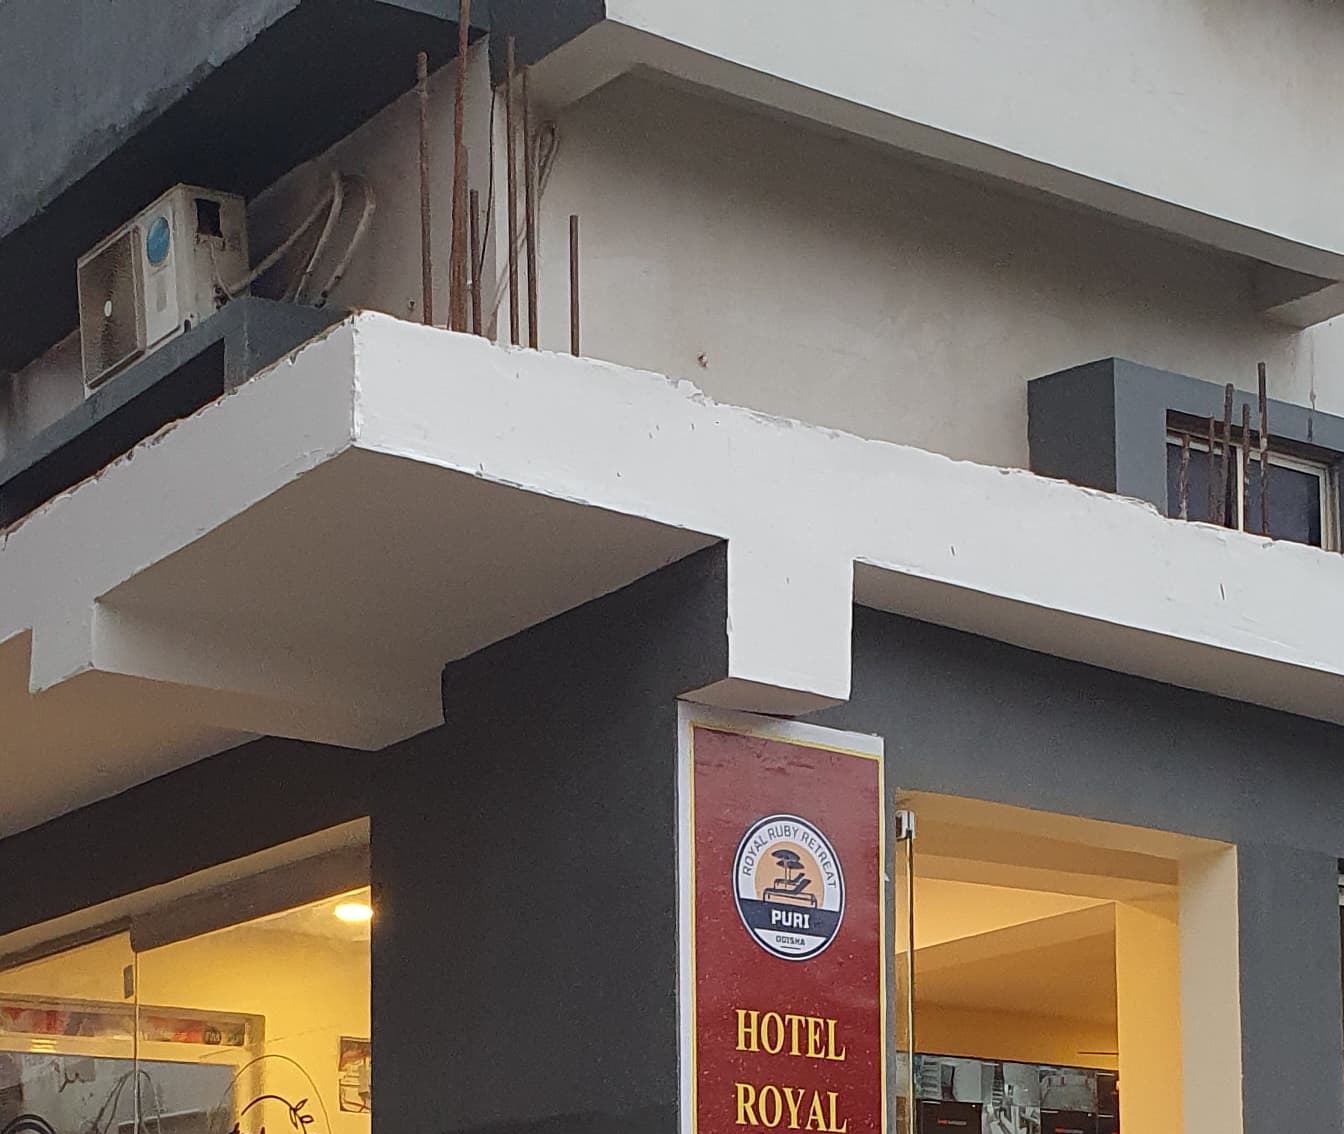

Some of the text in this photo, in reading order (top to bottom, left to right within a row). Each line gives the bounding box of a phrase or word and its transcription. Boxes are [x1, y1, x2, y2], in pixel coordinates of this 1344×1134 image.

[742, 825, 837, 889] ROYAL RUBY RETREAT
[771, 909, 810, 929] PURI
[775, 935, 806, 946] ODISHA
[735, 1008, 847, 1061] HOTEL
[735, 1083, 848, 1133] ROYAL
